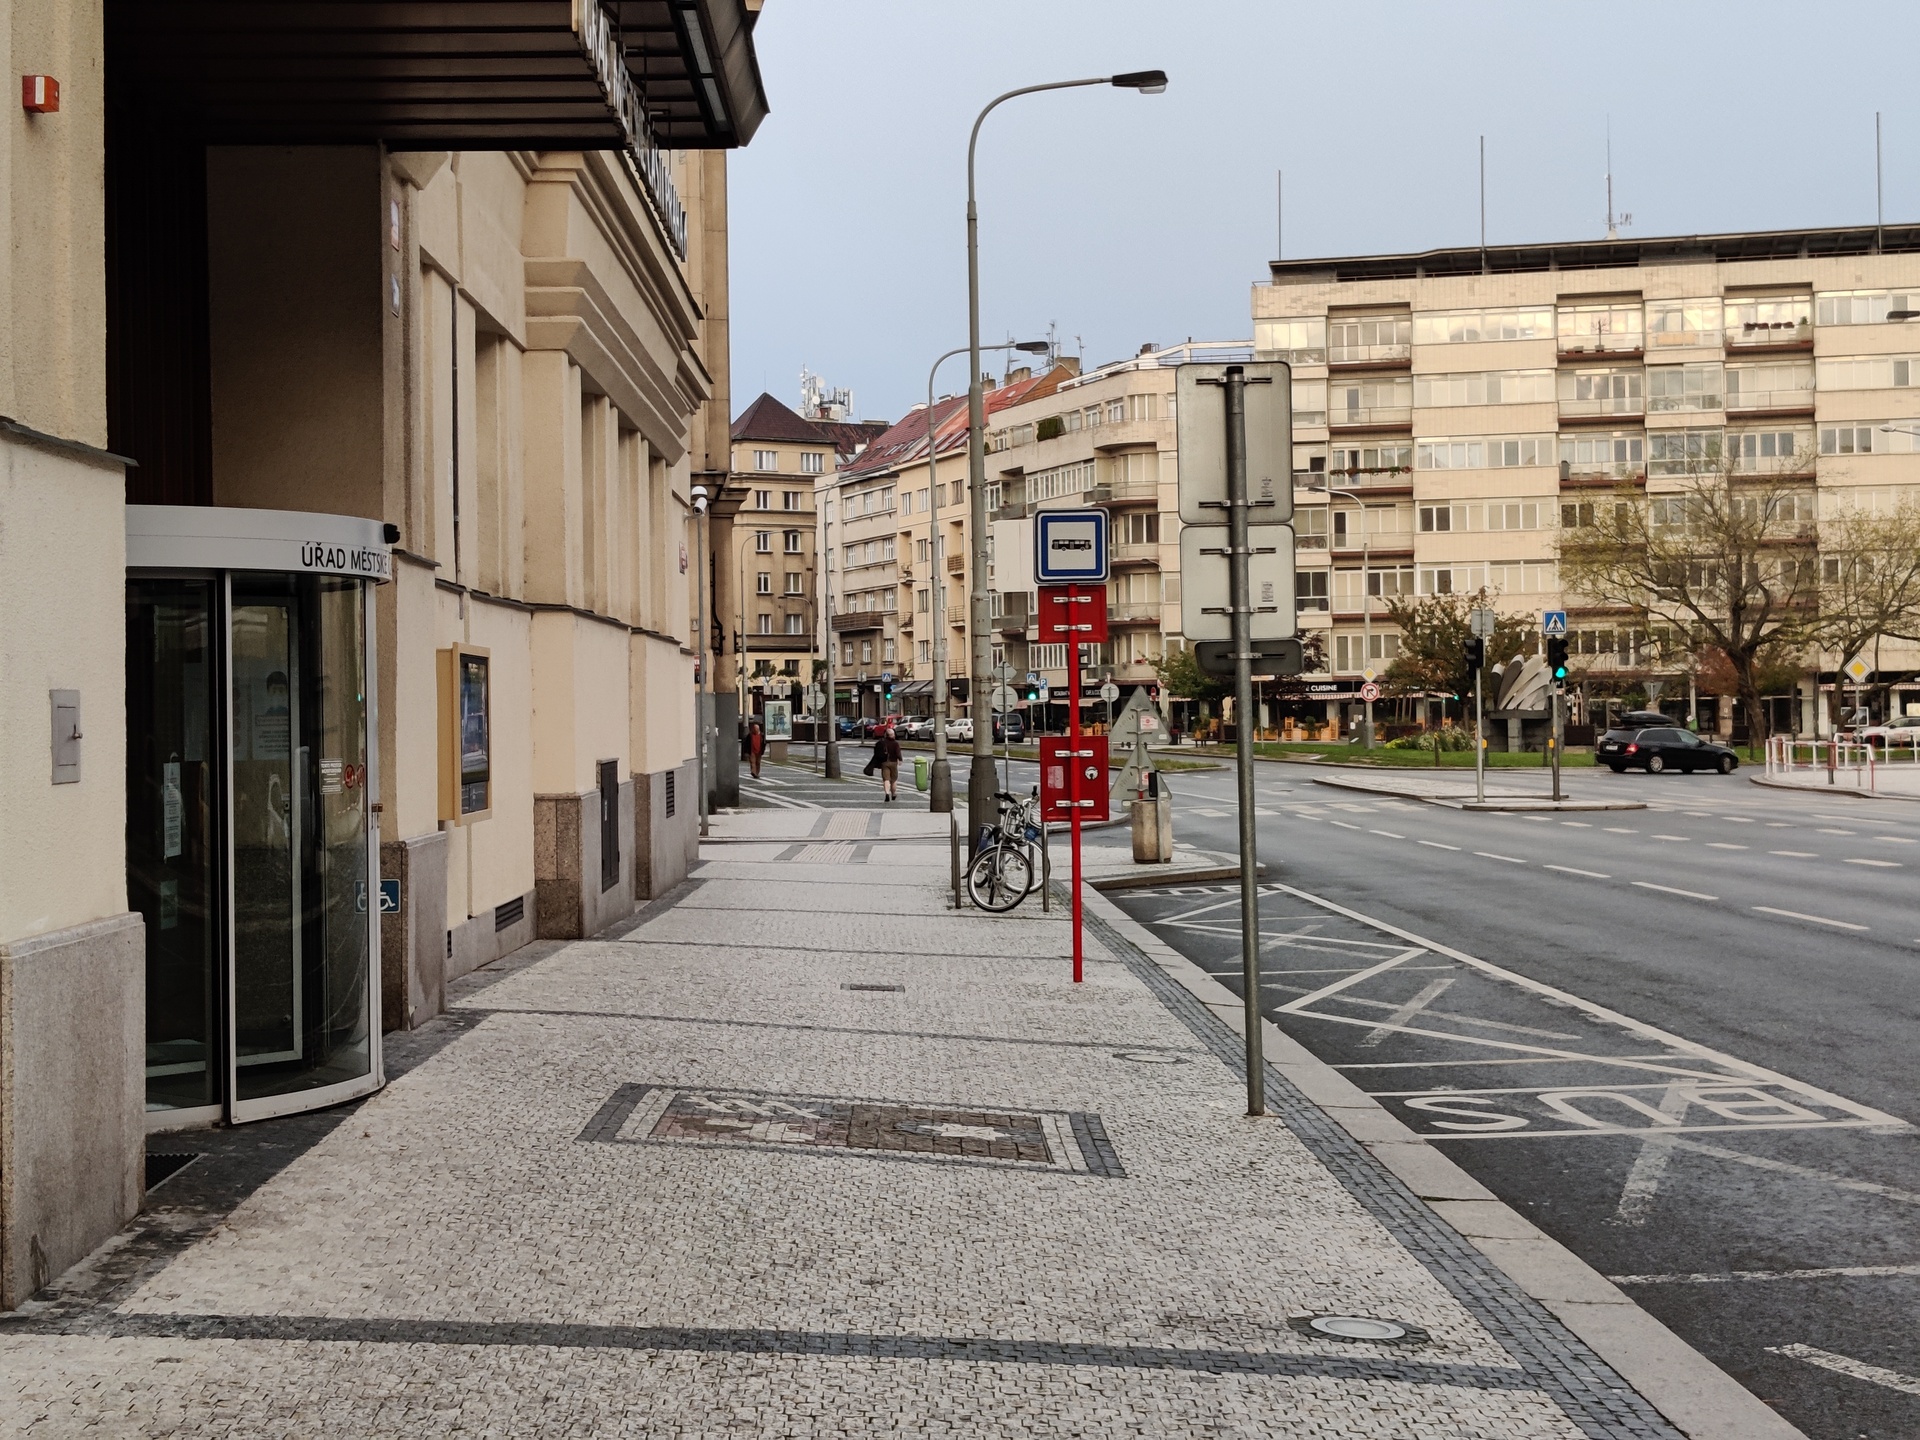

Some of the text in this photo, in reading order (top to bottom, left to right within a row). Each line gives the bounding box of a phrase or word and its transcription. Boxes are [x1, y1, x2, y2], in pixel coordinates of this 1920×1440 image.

[301, 541, 346, 569] ÚŘAD
[1310, 684, 1338, 692] CUISINE
[1404, 1087, 1827, 1131] BUS
